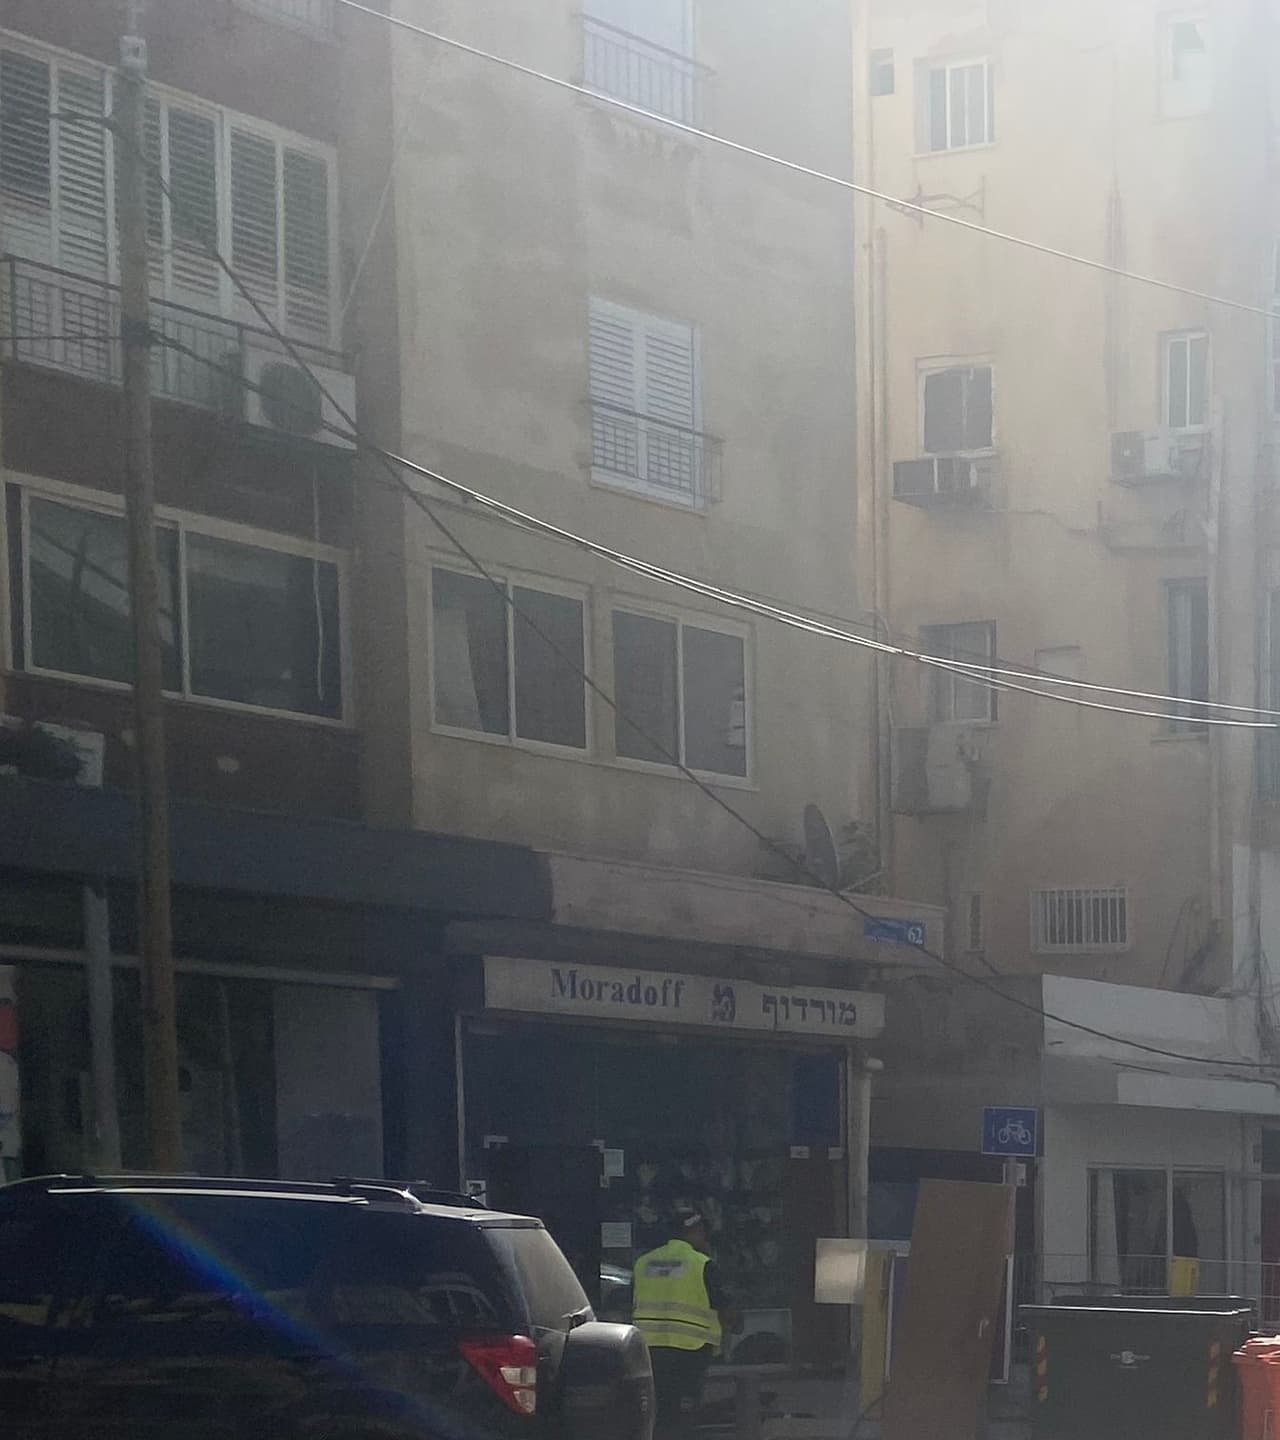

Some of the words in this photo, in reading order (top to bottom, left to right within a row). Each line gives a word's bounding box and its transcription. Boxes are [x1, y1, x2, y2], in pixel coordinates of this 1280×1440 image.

[907, 926, 924, 945] 62
[550, 968, 685, 1009] Moradoff
[762, 992, 857, 1030] מורדוף
